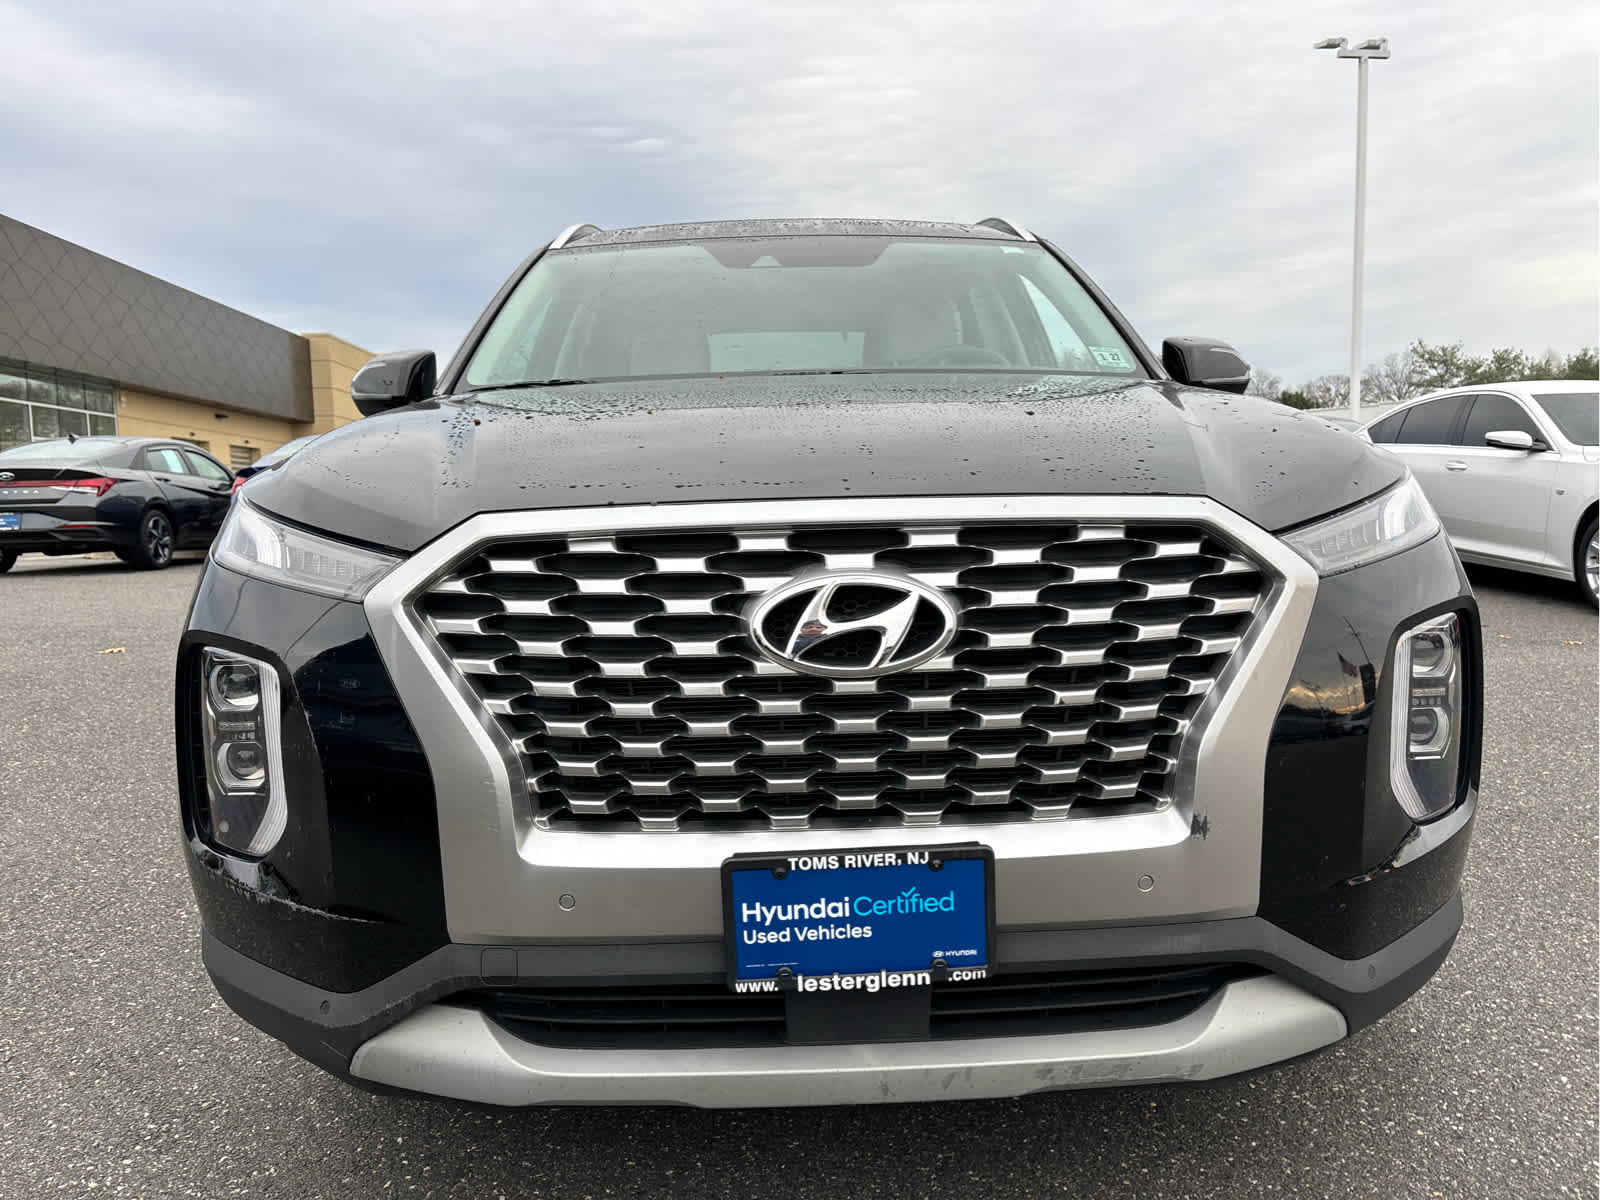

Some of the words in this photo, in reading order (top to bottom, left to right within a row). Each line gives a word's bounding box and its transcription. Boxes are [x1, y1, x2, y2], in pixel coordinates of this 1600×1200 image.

[787, 855, 840, 871] TOMS
[844, 853, 902, 869] RIVER,
[907, 852, 929, 865] NJ
[742, 896, 850, 926] Hyundai
[853, 886, 954, 916] Certified
[743, 926, 791, 945] Used
[794, 923, 873, 941] Vehicles
[945, 949, 977, 957] HYUNDAI
[735, 980, 779, 993] www.
[797, 969, 931, 992] lesterglenn
[948, 969, 986, 982] .com
